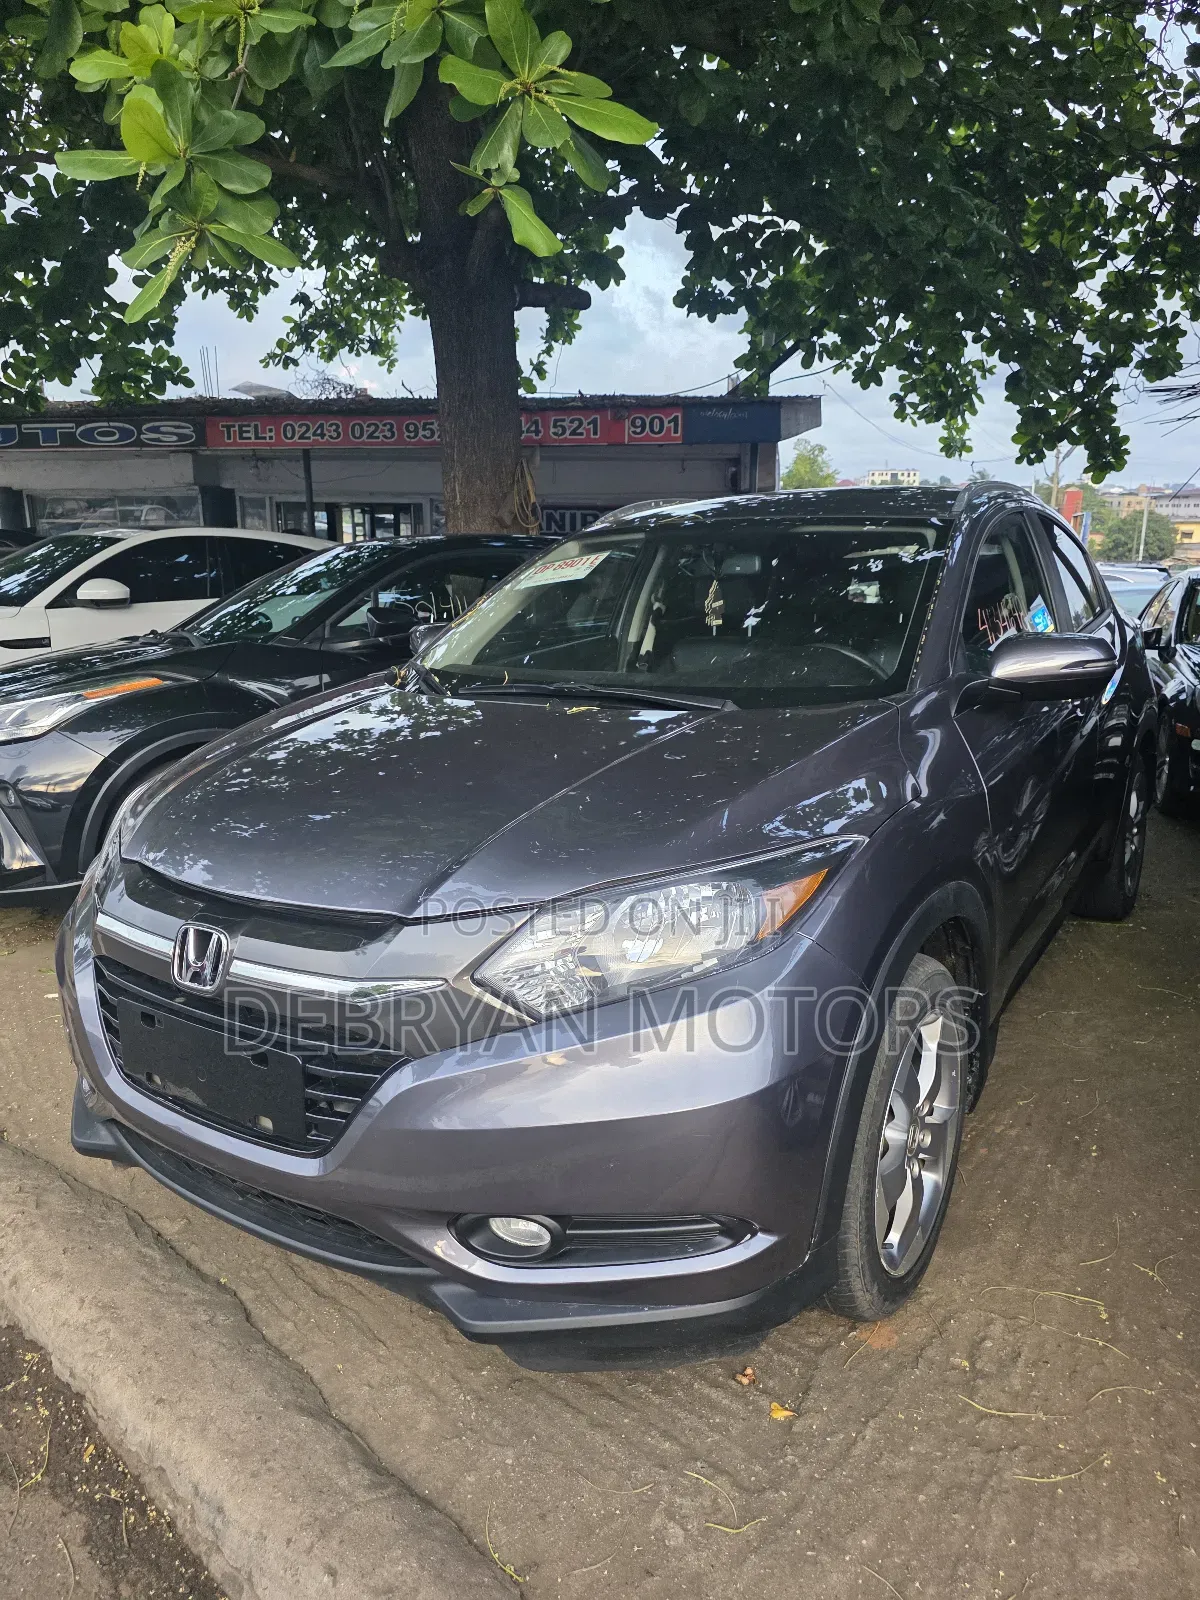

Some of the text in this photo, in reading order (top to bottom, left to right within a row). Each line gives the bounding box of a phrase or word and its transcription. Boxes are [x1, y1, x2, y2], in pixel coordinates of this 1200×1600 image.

[220, 422, 275, 442] TEL:
[281, 421, 342, 442] 0243
[350, 420, 396, 442] 023
[404, 420, 440, 442] 95
[549, 414, 601, 438] 521
[628, 412, 682, 436] 901
